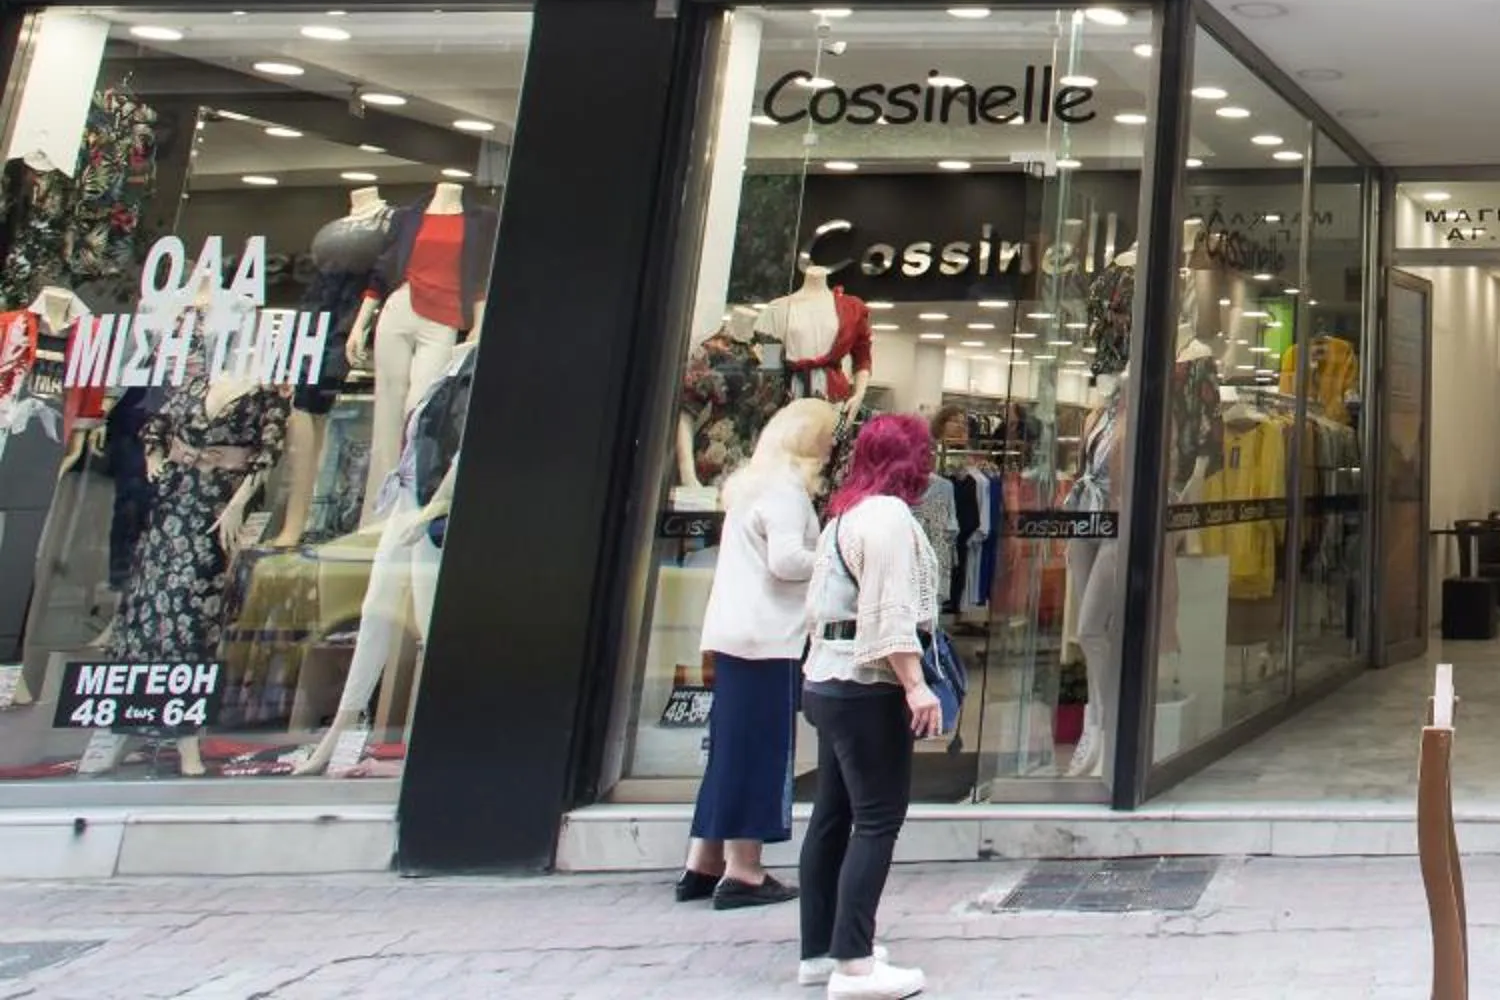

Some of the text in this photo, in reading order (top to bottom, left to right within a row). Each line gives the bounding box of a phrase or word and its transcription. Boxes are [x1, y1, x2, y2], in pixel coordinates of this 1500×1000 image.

[763, 65, 1097, 125] Cossinelle
[799, 211, 1119, 276] Cossinell
[64, 311, 331, 388] ΜΙΣΗ ΤΙΜΗ
[75, 663, 219, 695] ΜΕΓΕΘΗ
[71, 698, 117, 726] 48
[162, 698, 207, 726] 64
